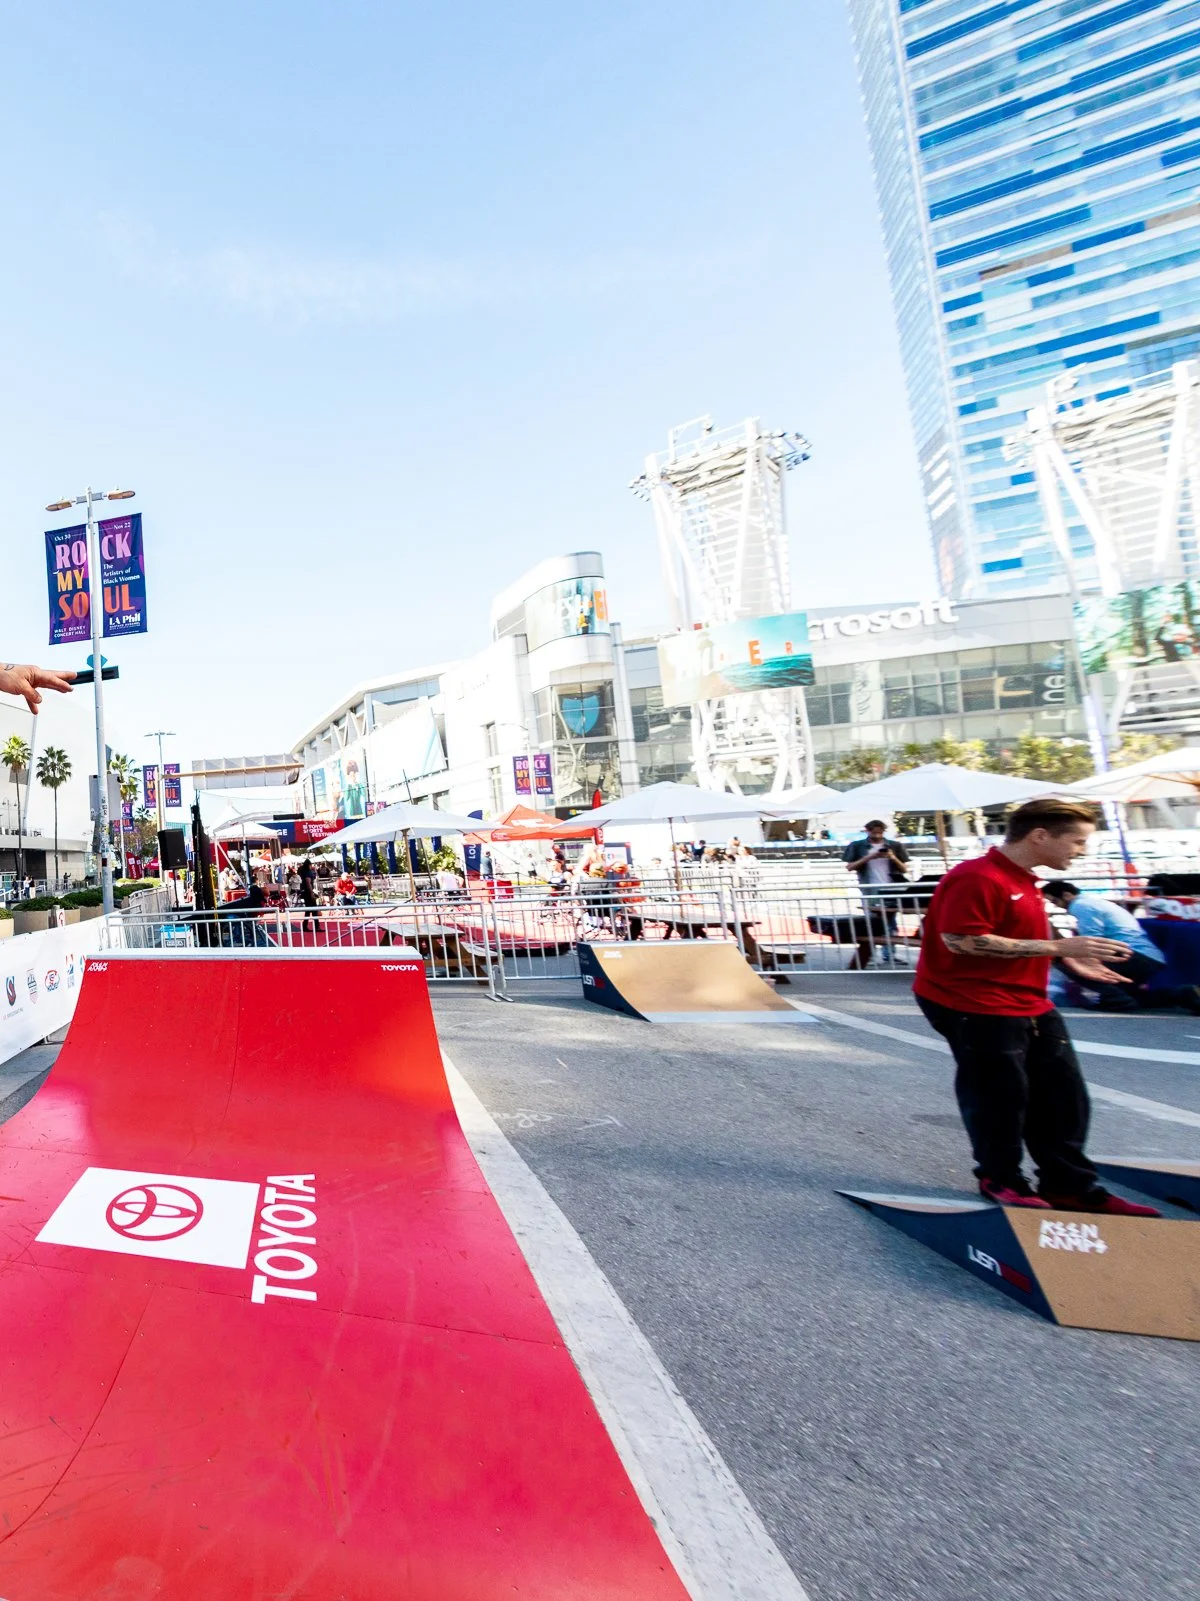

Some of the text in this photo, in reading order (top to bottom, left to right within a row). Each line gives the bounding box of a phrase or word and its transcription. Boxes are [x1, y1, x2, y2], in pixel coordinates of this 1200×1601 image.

[57, 566, 85, 592] MY
[103, 569, 124, 578] Artistry
[103, 574, 140, 585] Black Women
[109, 616, 121, 626] LA
[122, 612, 141, 623] Phil
[807, 597, 960, 641] crosoft
[251, 1174, 318, 1304] TOYOTA
